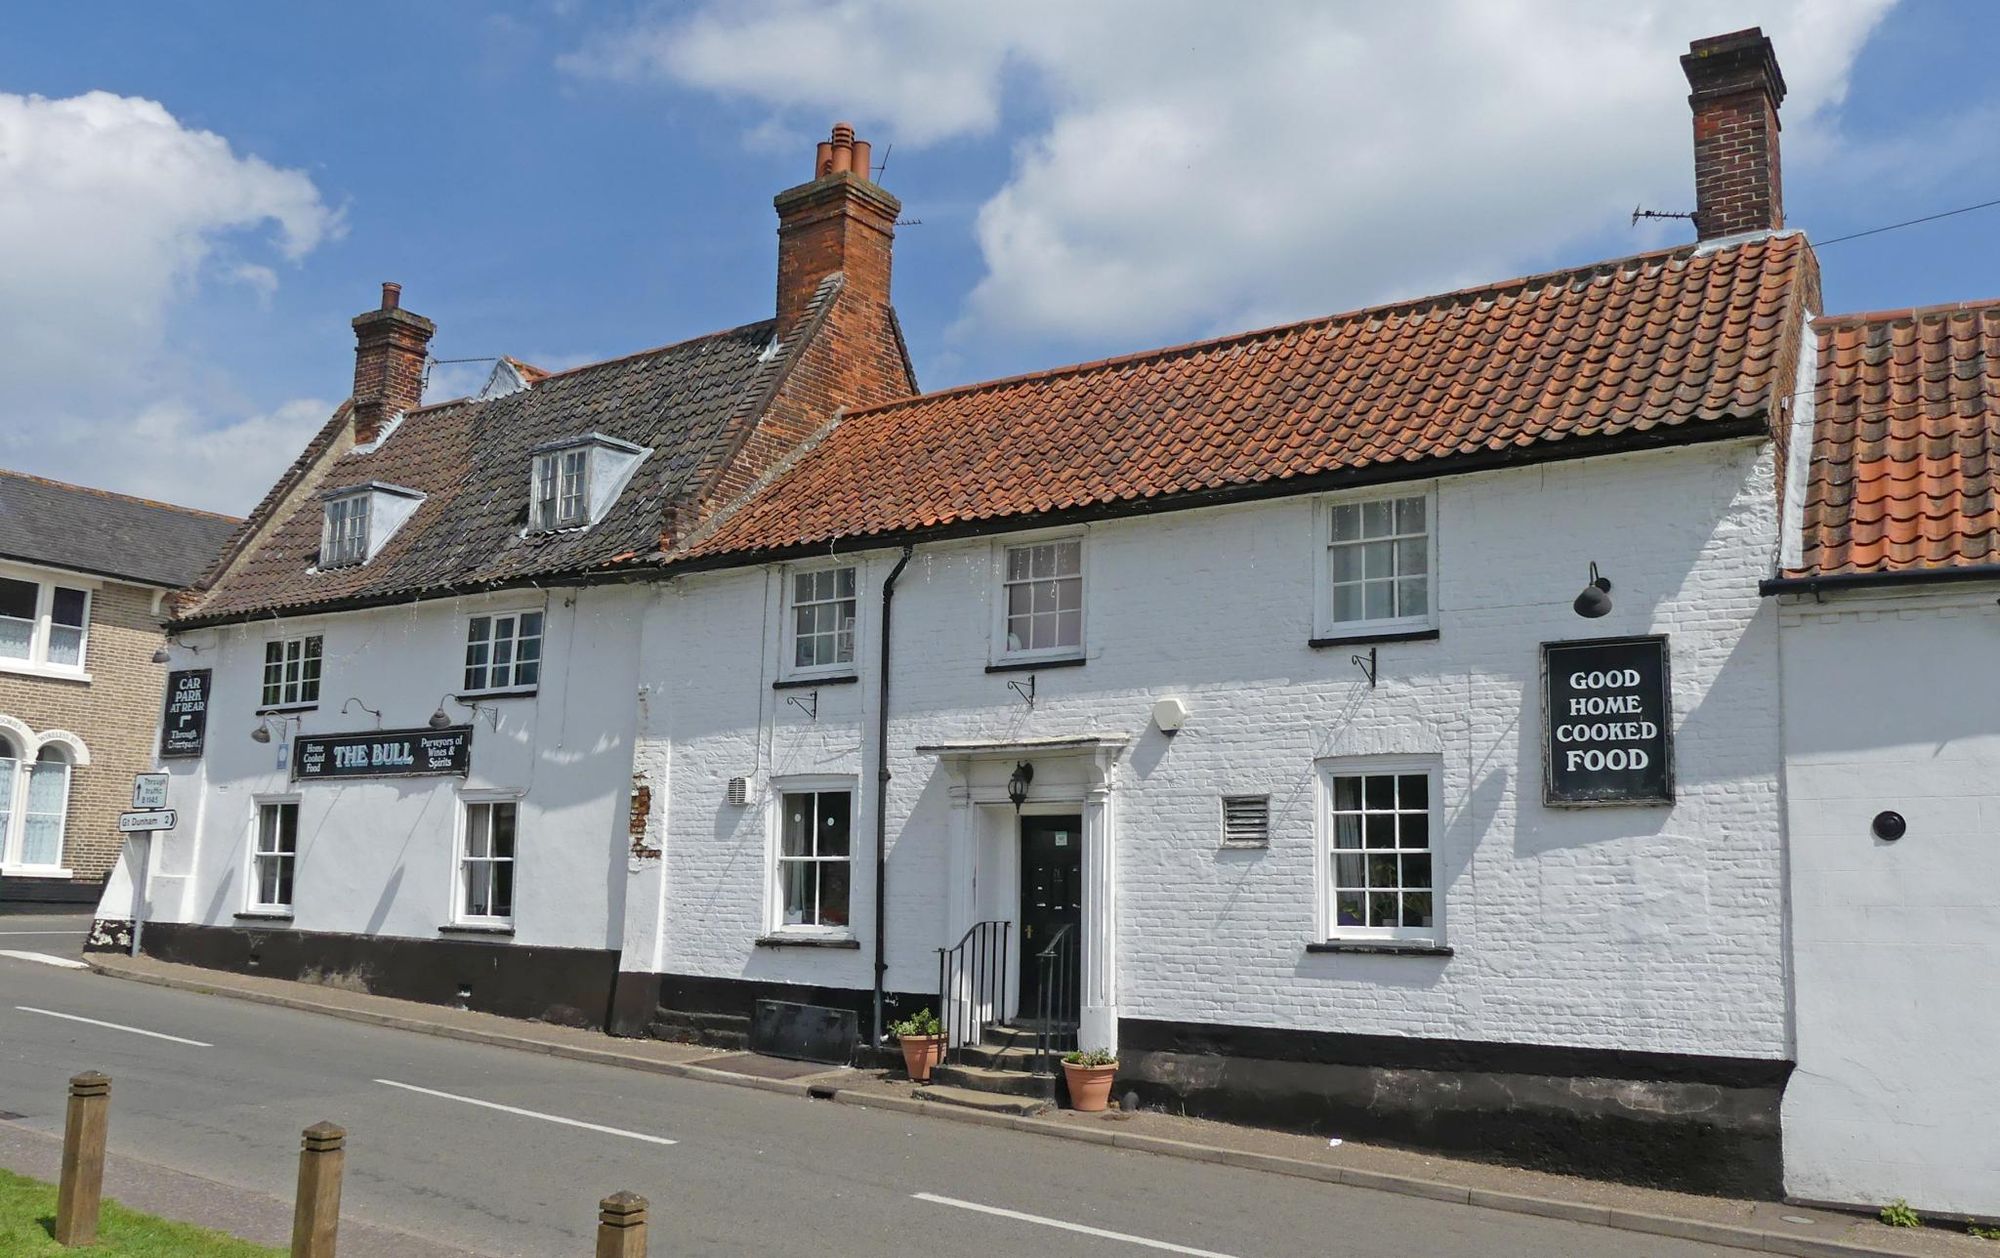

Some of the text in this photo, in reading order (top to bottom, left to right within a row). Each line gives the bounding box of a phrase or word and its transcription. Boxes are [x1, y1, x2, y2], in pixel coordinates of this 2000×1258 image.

[180, 677, 201, 690] CAR
[1569, 669, 1641, 689] GOOD
[175, 689, 202, 703] PARK
[169, 701, 205, 713] AT REAR
[1569, 695, 1643, 716] HOME
[171, 728, 197, 740] Through
[1556, 721, 1658, 743] COOKED
[421, 734, 463, 748] Purveyors of
[306, 743, 325, 753] Home
[427, 745, 456, 757] Wines &
[303, 753, 326, 763] Cooked
[333, 742, 415, 768] THE BULL
[1566, 748, 1649, 772] FOOD
[306, 763, 321, 773] Food
[428, 757, 452, 770] Spirits
[122, 815, 170, 827] Gt Dunham 2
